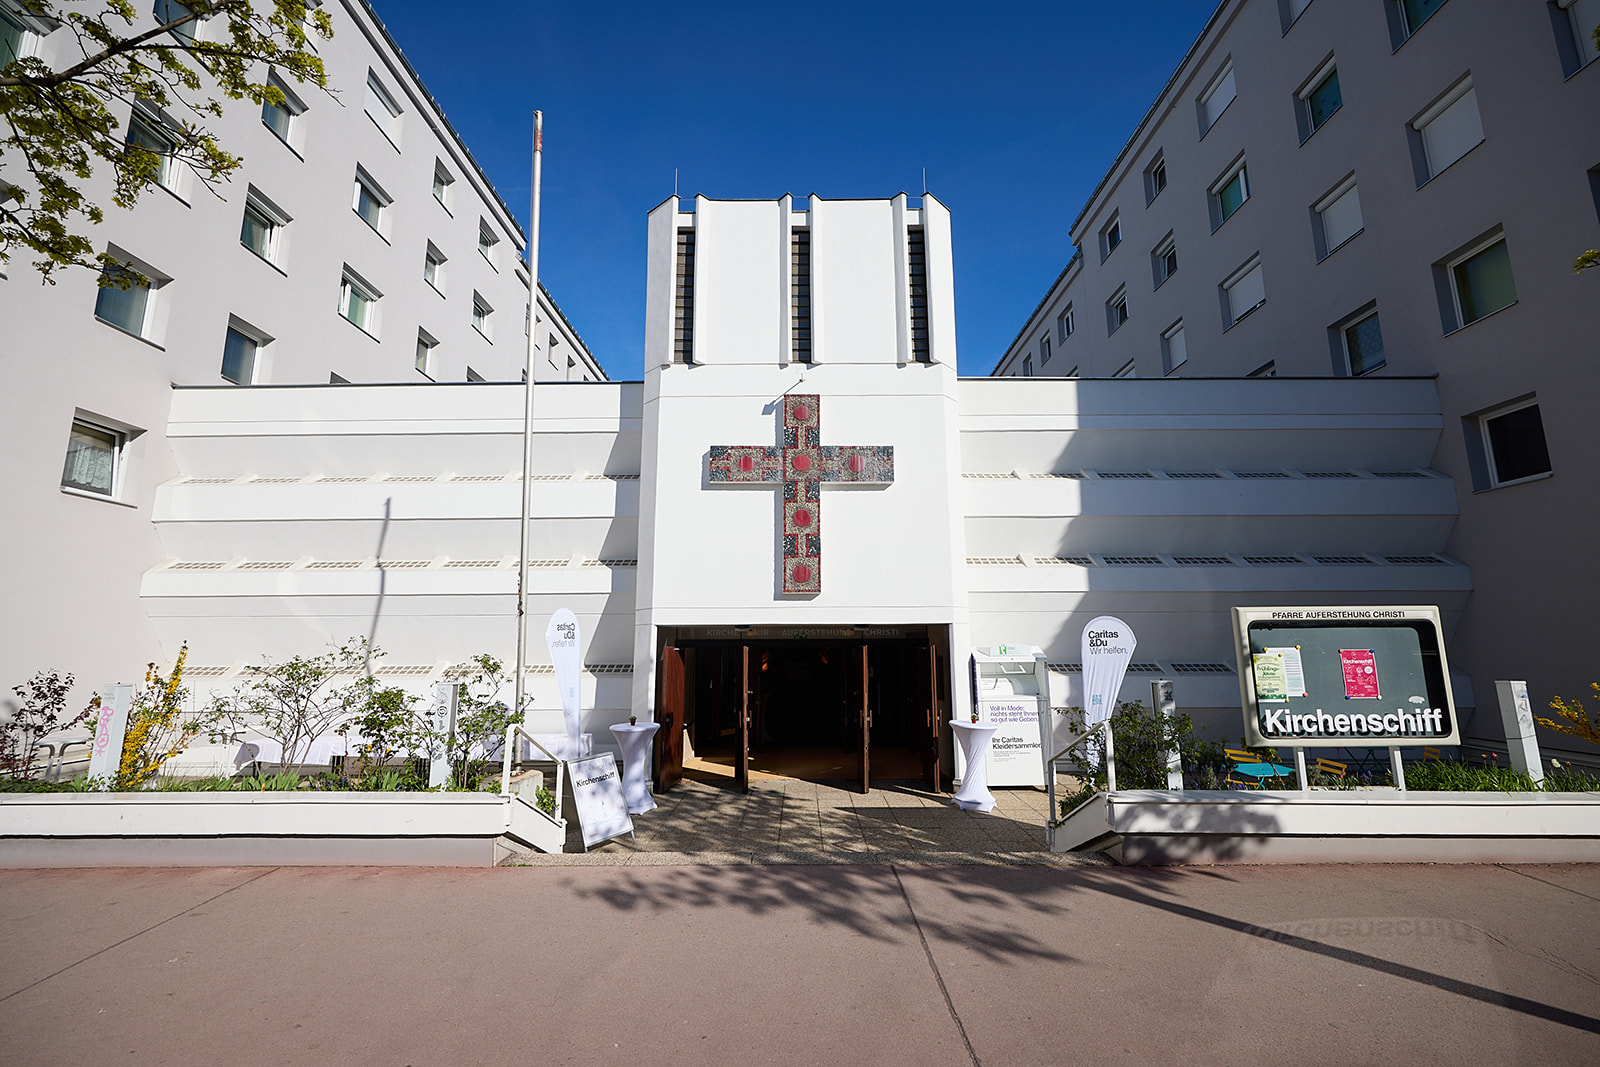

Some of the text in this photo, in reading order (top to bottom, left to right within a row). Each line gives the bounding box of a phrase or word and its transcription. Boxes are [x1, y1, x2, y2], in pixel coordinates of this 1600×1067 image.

[1272, 610, 1405, 619] PFARRE AUFERSTEHUNG CHRISTI
[706, 628, 738, 637] KIRCHE
[782, 628, 853, 637] AUFERSTEHUNG
[864, 628, 899, 637] CHRISTI
[1088, 630, 1119, 639] Caritas
[1089, 639, 1108, 647] &Du
[1090, 646, 1129, 655] Wir helfen.
[1265, 708, 1442, 733] Kirchenschiff
[576, 771, 615, 787] Kirchenschiff
